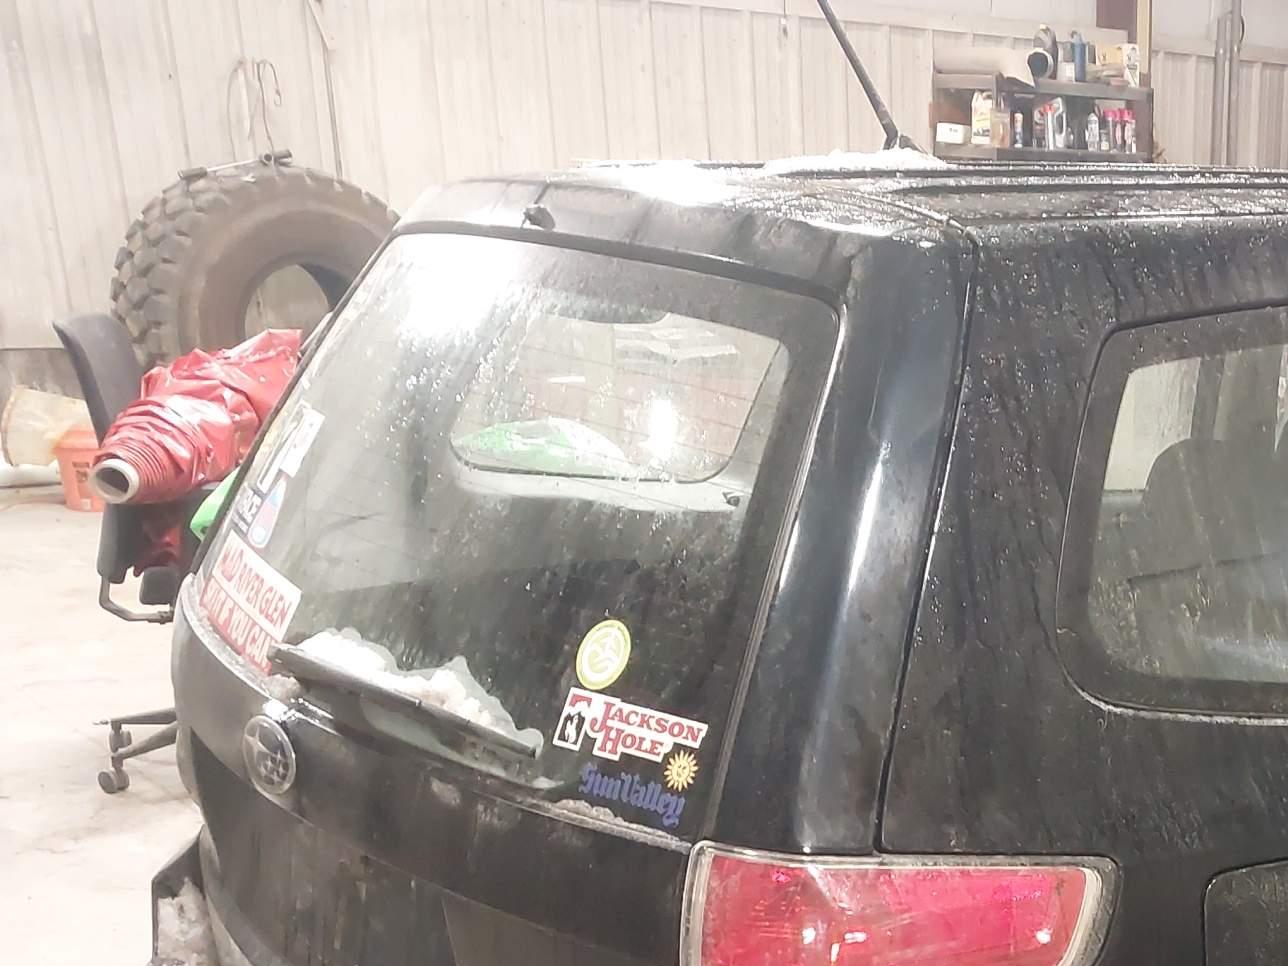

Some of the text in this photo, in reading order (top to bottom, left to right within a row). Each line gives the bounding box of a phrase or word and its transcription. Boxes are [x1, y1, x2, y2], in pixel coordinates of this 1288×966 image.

[236, 561, 265, 608] RIVER
[258, 584, 293, 630] GLEN
[226, 604, 254, 647] YOU
[589, 700, 704, 744] JACKSON
[597, 724, 665, 757] HOLE
